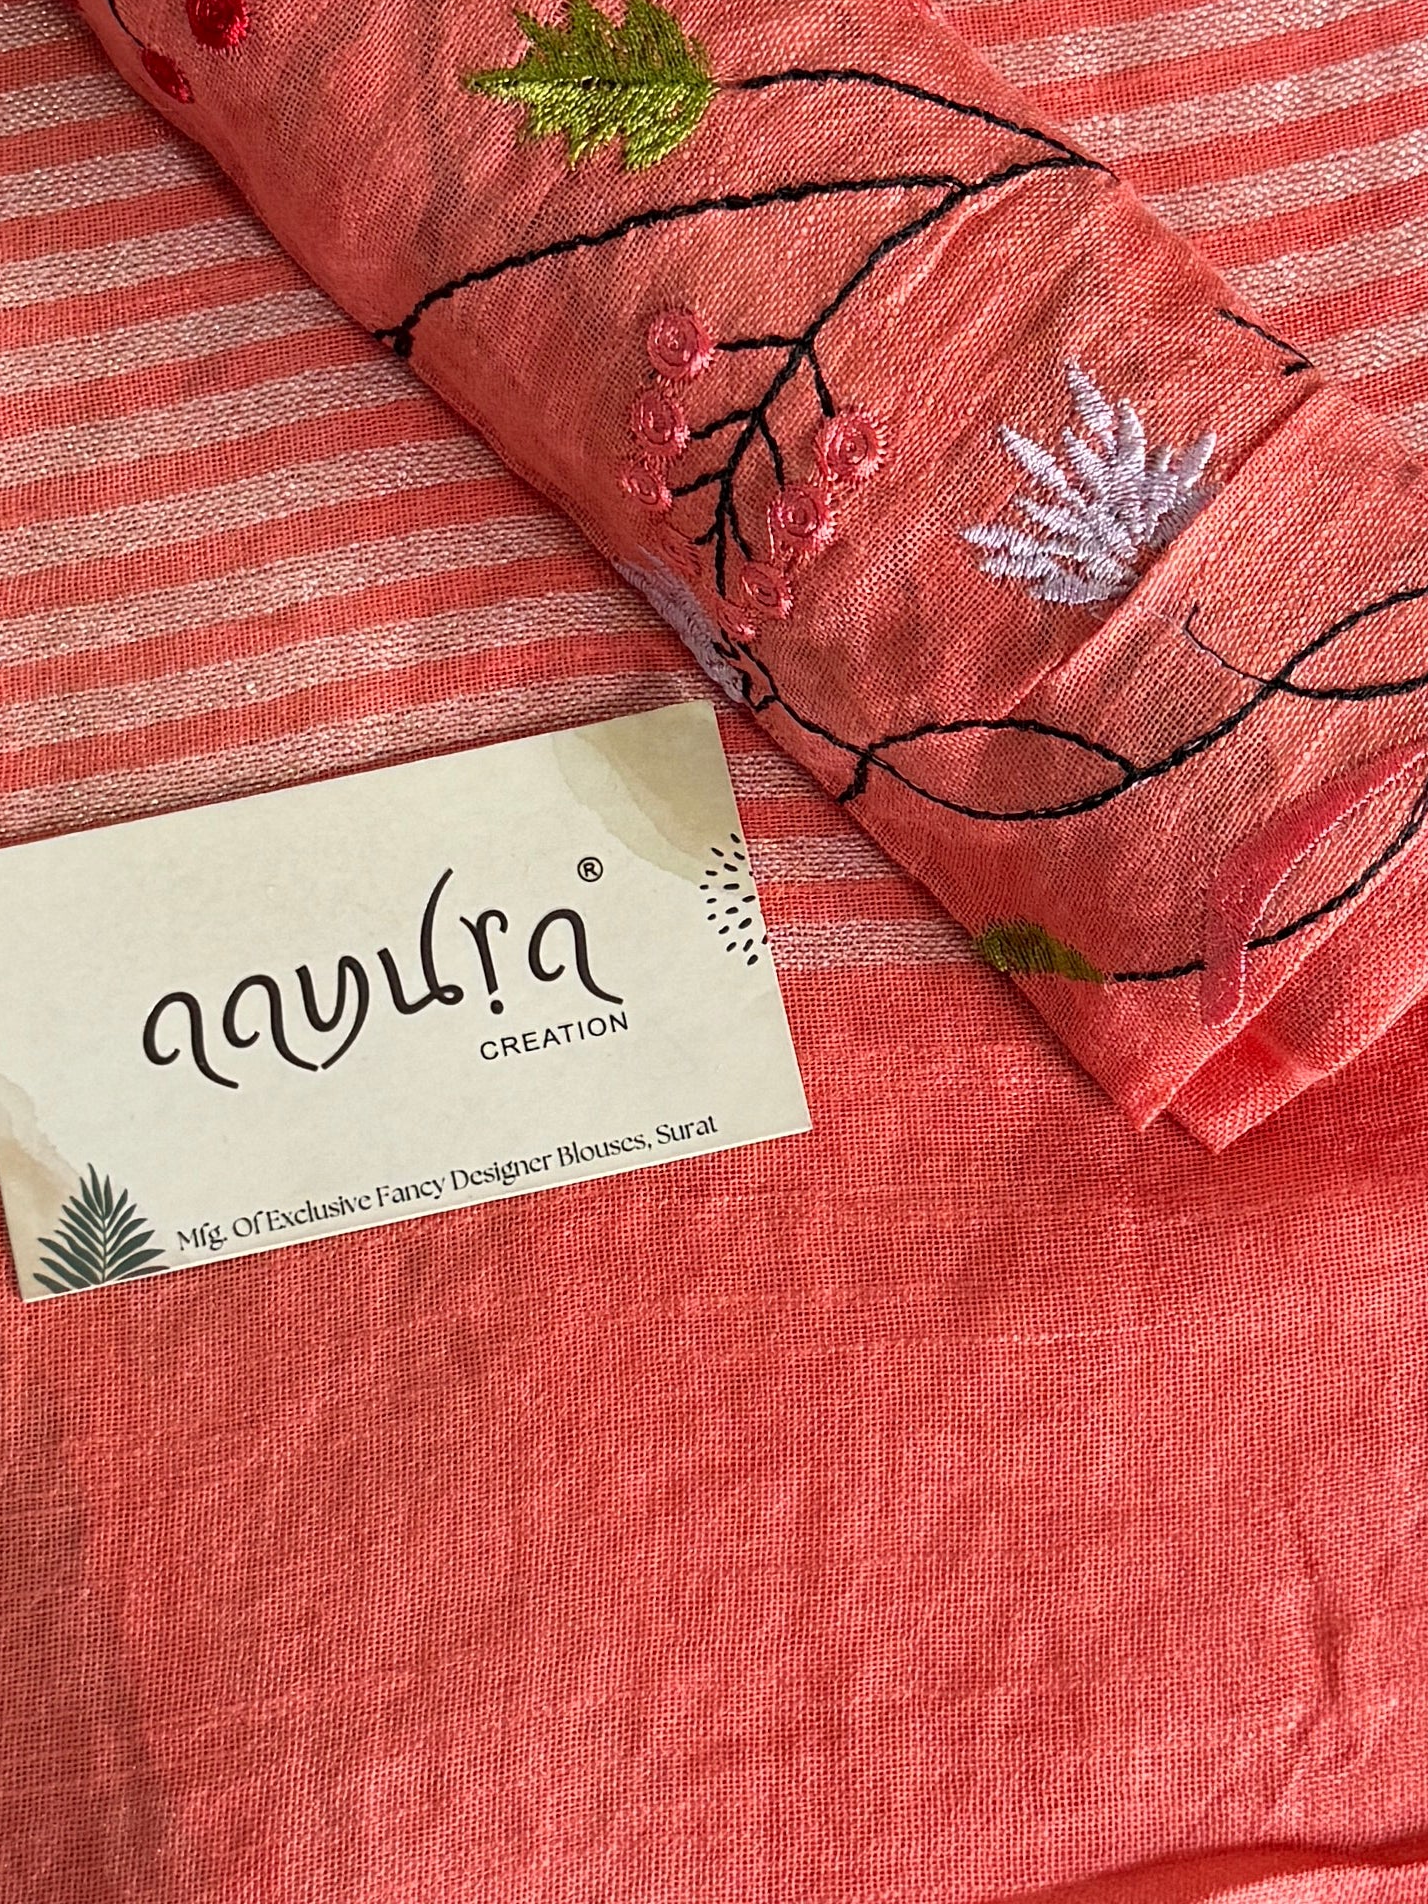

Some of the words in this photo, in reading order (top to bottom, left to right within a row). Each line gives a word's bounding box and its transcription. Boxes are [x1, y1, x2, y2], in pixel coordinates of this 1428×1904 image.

[480, 1011, 630, 1062] CREATION
[175, 1221, 228, 1253] Mfg.
[232, 1210, 264, 1238] Of
[265, 1193, 372, 1233] Exclusive
[375, 1178, 447, 1209] Fancy
[449, 1154, 553, 1192] Designer
[556, 1137, 655, 1168] Blouses,
[655, 1115, 719, 1146] Surat
